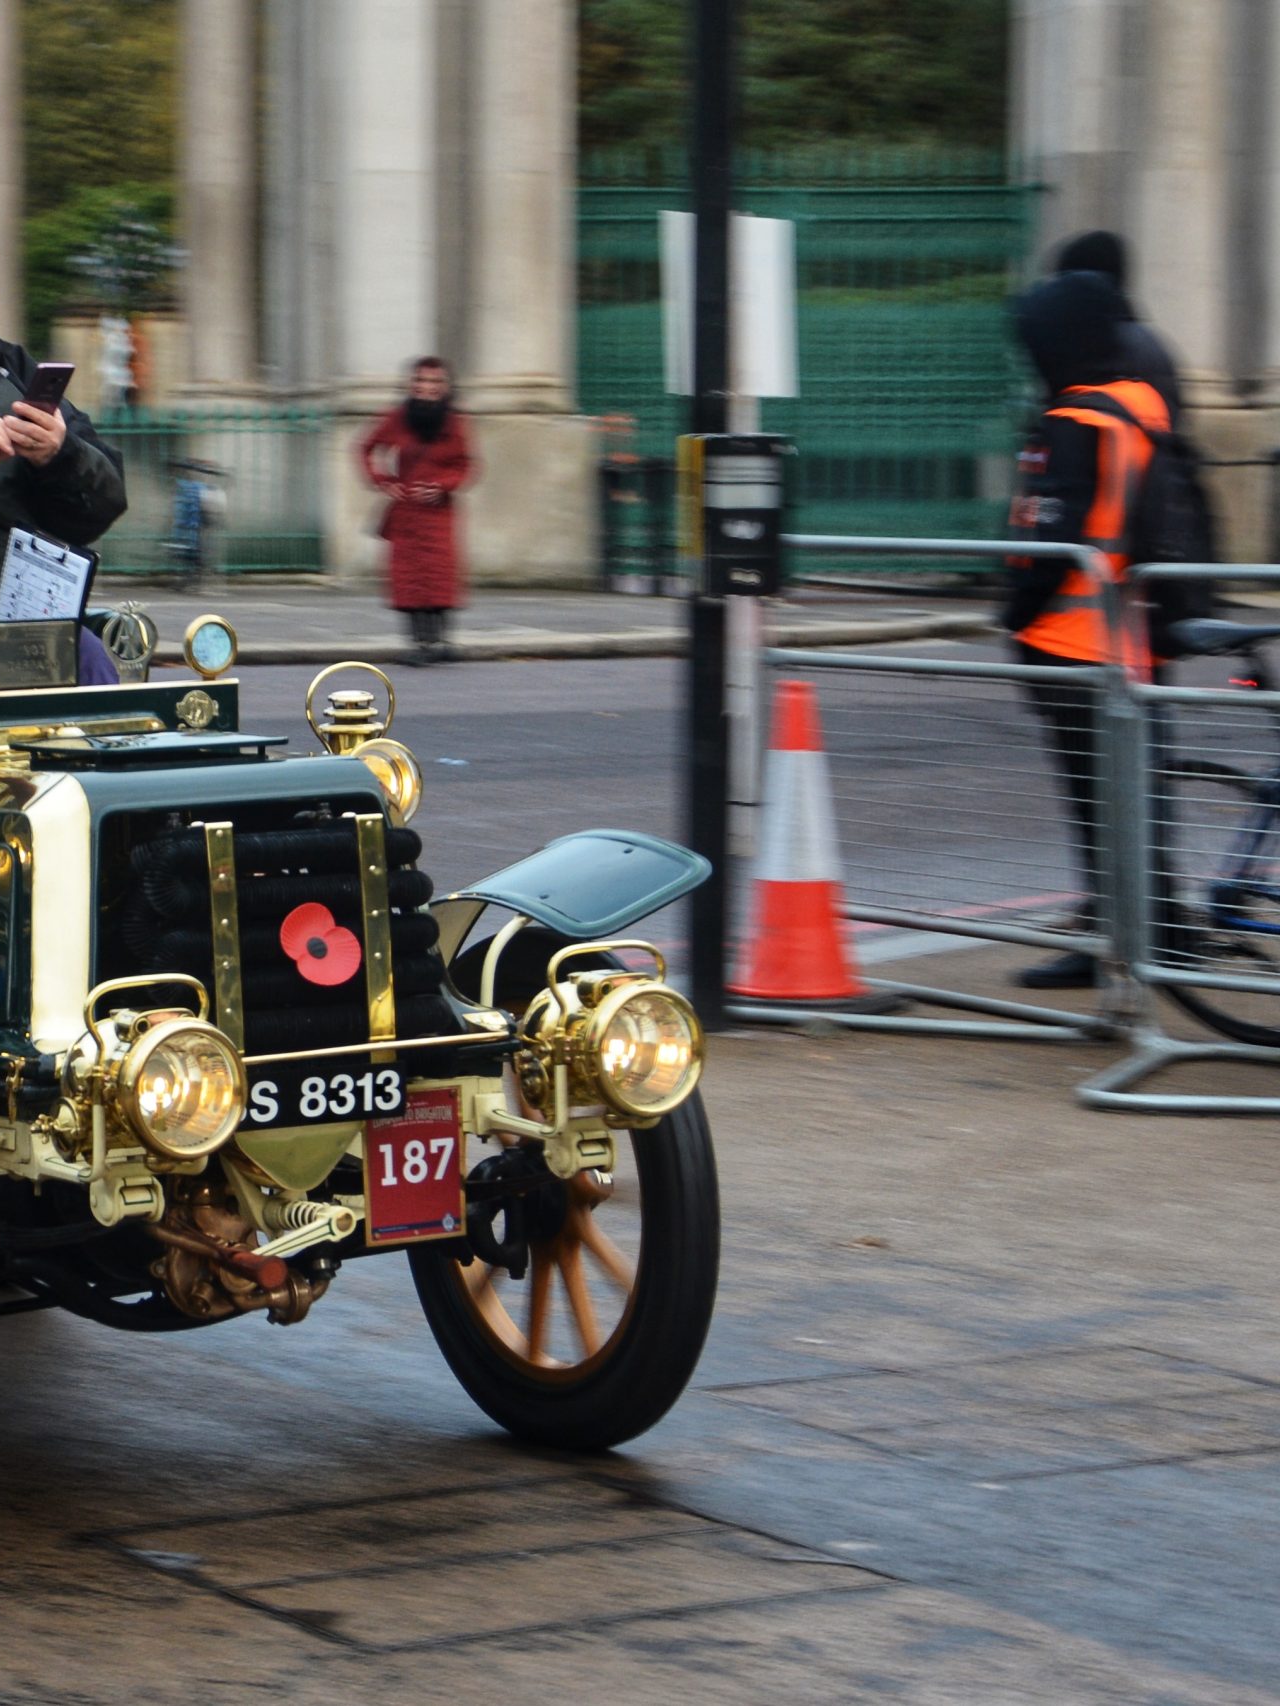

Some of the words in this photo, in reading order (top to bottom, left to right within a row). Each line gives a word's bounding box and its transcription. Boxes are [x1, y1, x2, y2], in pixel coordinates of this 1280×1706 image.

[240, 1080, 279, 1123] S
[299, 1069, 402, 1118] 8313
[414, 1104, 453, 1122] BRIGHTON
[379, 1136, 455, 1187] 187
